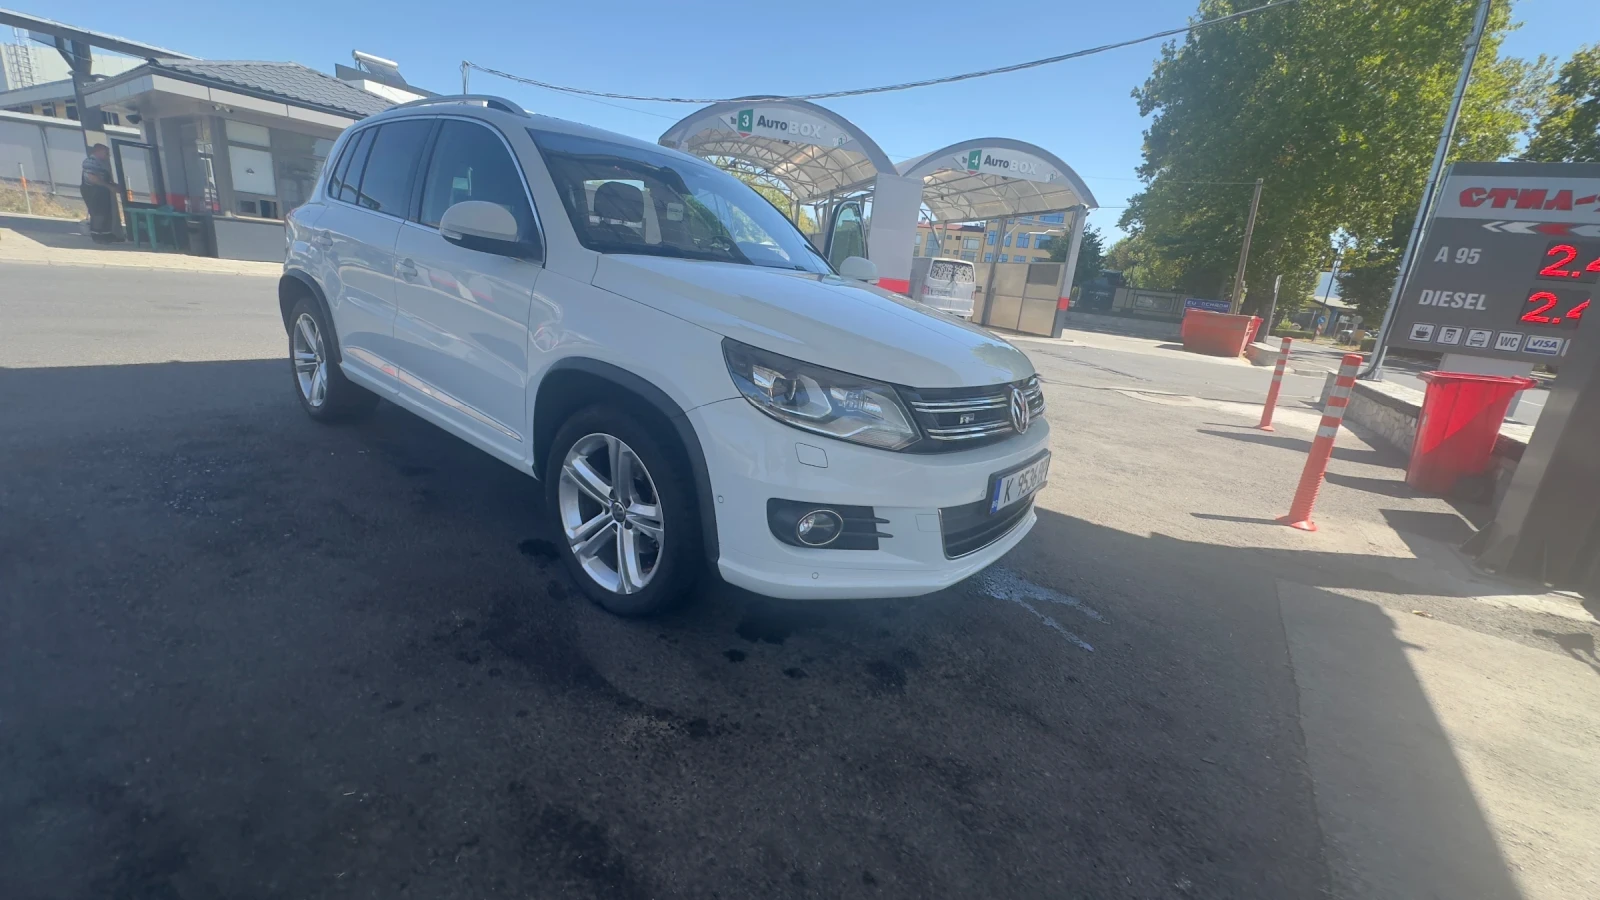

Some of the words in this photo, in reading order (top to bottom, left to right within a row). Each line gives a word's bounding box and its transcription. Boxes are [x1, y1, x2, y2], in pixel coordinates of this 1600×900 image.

[741, 114, 750, 127] 3
[971, 155, 979, 166] 4
[1459, 187, 1600, 212] СТИЛ-
[1434, 246, 1448, 263] A
[1455, 248, 1482, 265] 95
[1418, 289, 1487, 311] DIESEL
[1500, 336, 1518, 348] WC
[1532, 339, 1558, 349] VISA
[1003, 478, 1014, 503] K
